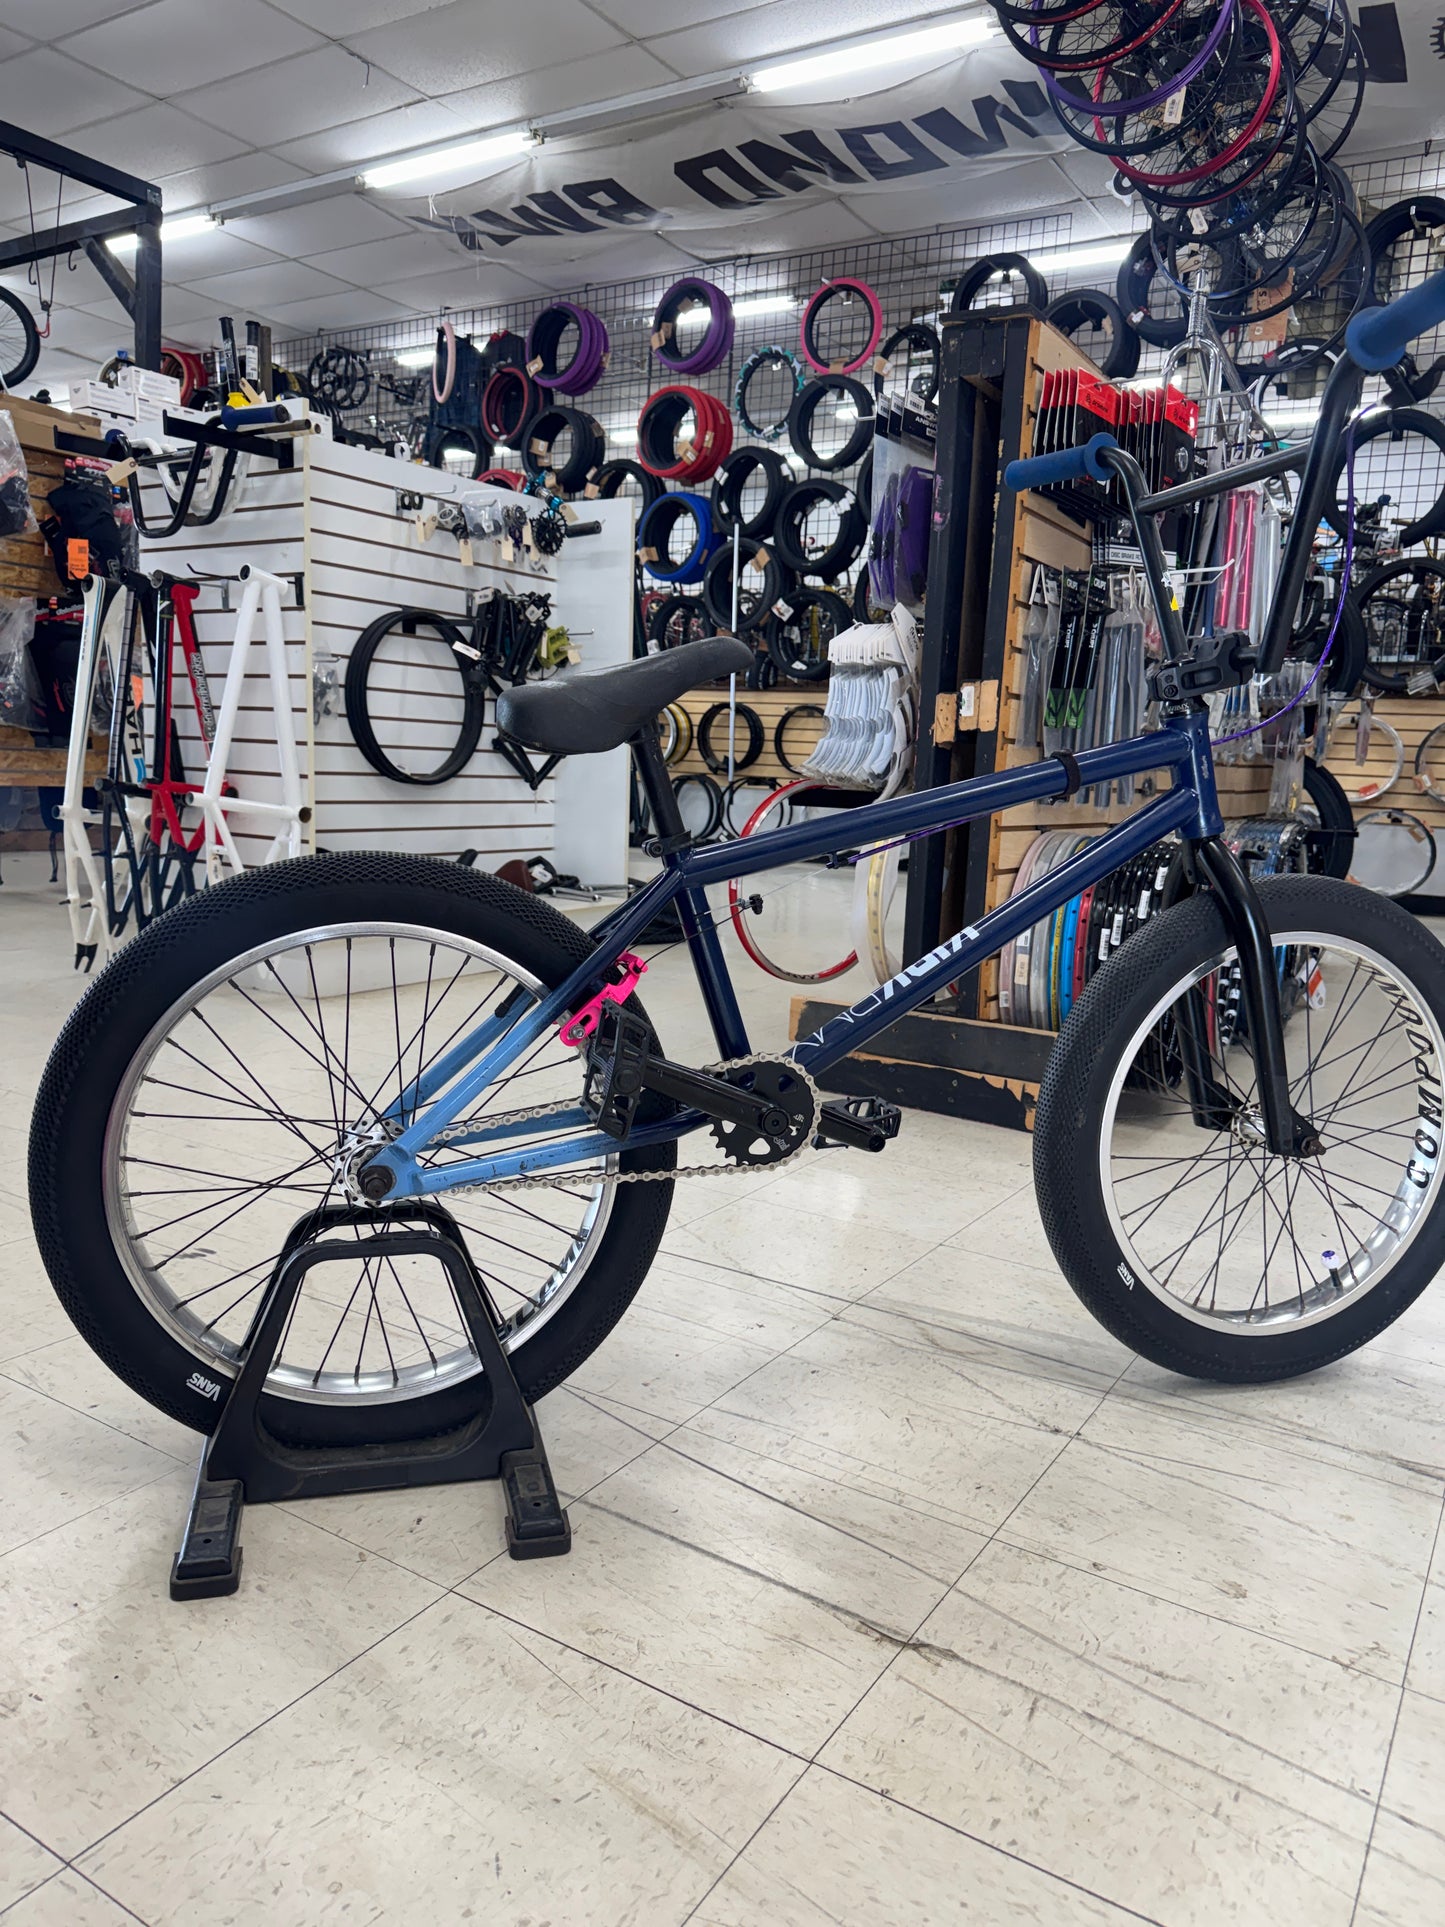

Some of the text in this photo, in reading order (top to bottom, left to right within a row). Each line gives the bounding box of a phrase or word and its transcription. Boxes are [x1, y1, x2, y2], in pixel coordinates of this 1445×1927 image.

[405, 178, 673, 250] BMX
[1356, 964, 1443, 1189] COMPOUND
[1116, 1262, 1135, 1291] VANS
[186, 1372, 221, 1402] VANS
